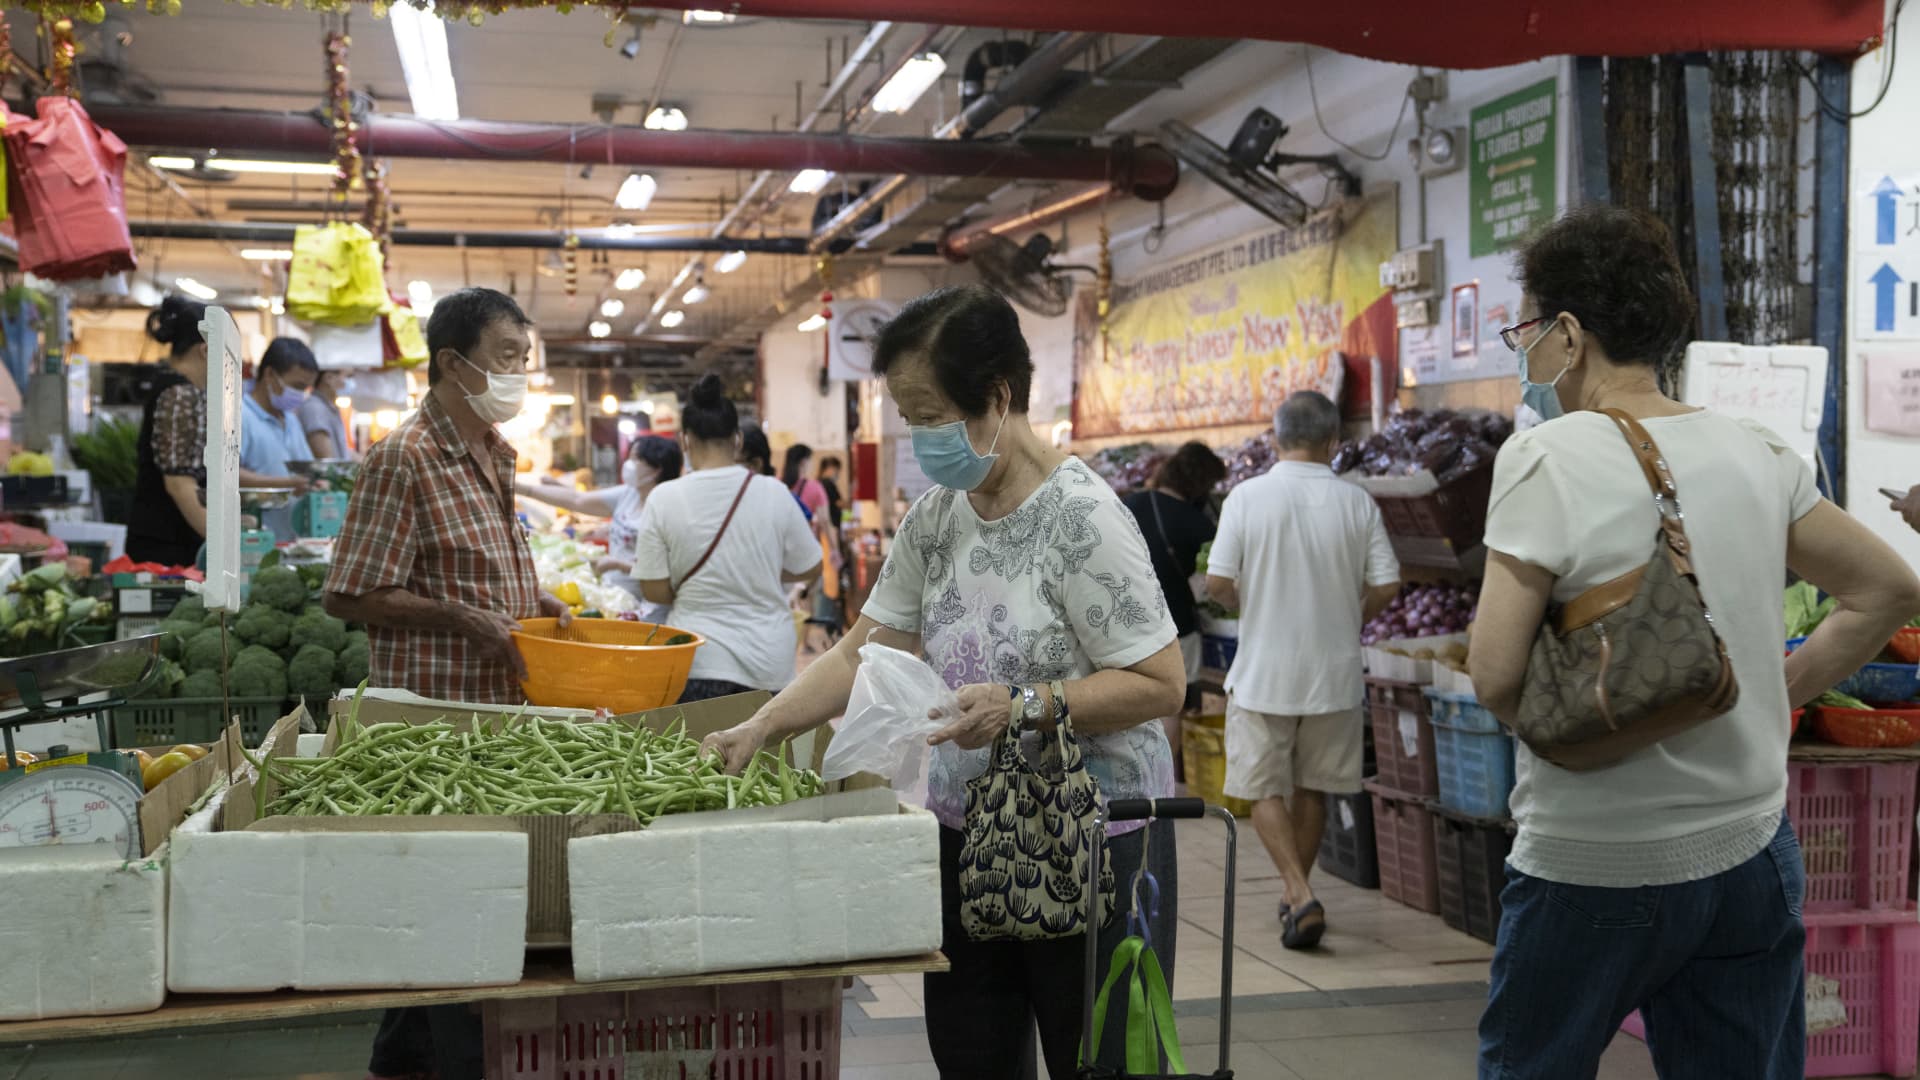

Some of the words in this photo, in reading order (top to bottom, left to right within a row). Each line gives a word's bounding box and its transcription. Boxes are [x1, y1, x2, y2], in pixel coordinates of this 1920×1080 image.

[1487, 130, 1520, 160] FLOWER
[1522, 121, 1548, 148] SHOP
[1208, 250, 1225, 275] PTE
[1228, 244, 1246, 271] LTD
[1242, 312, 1289, 352] New
